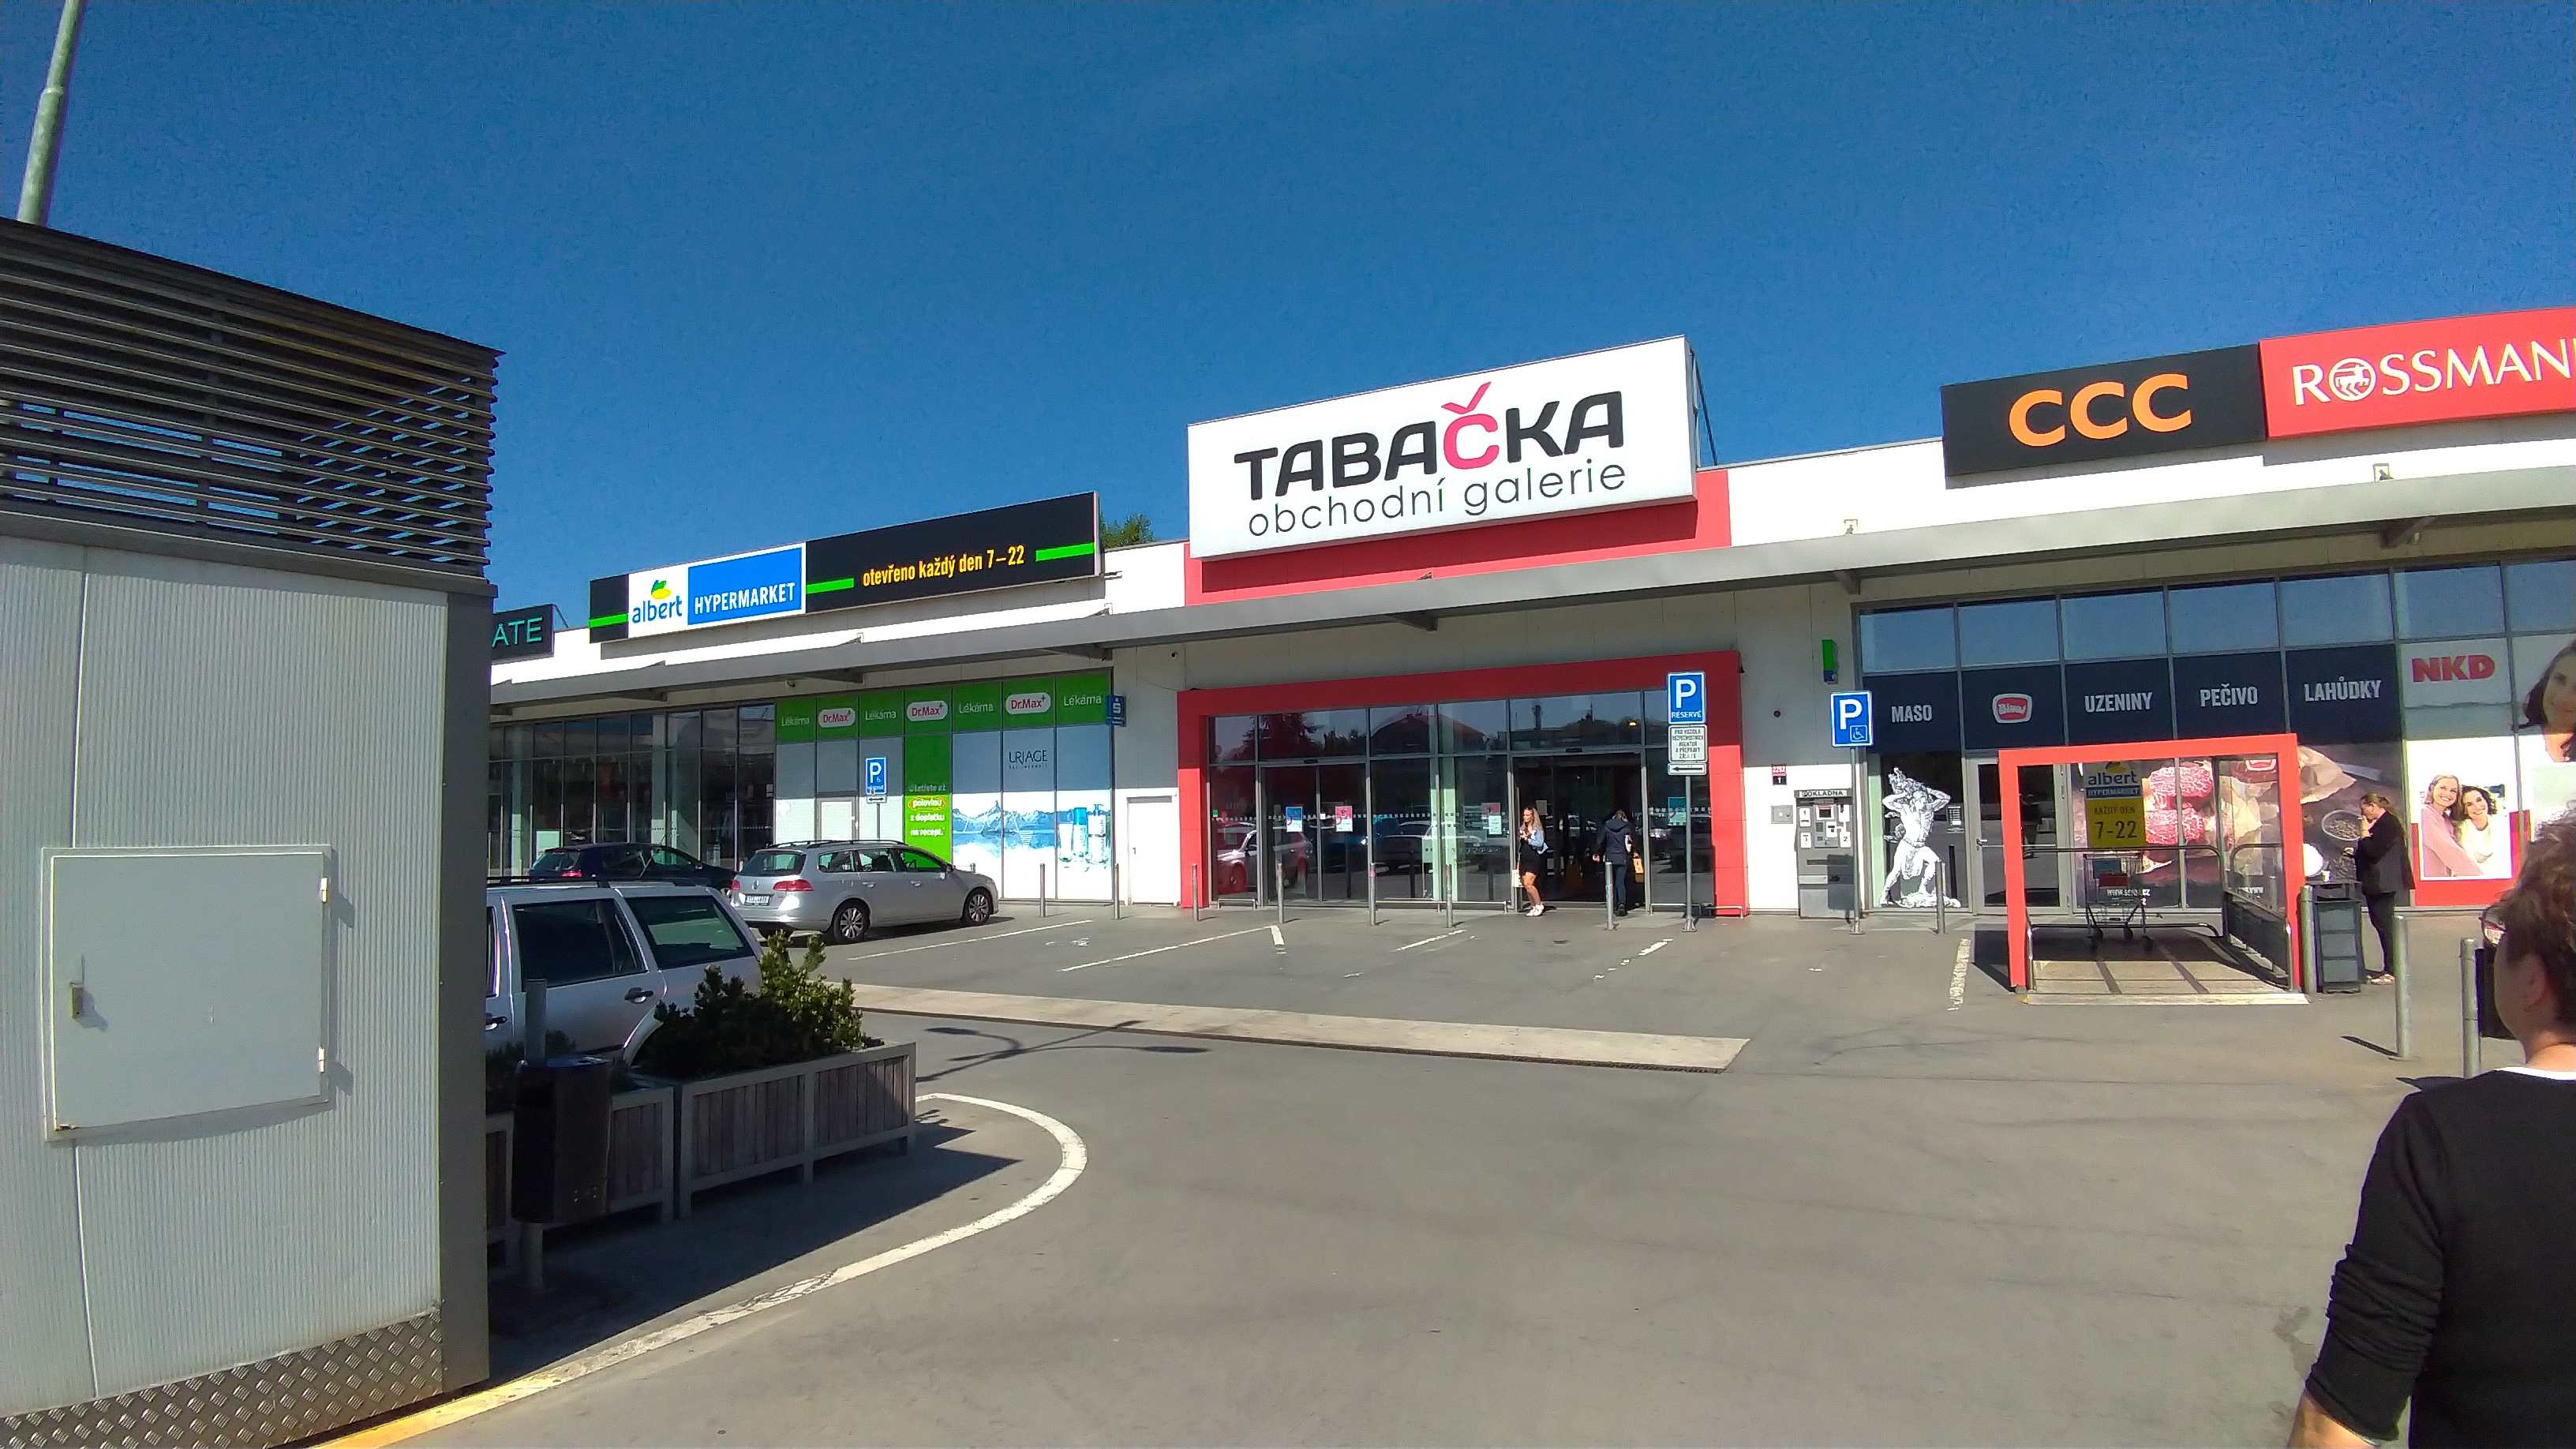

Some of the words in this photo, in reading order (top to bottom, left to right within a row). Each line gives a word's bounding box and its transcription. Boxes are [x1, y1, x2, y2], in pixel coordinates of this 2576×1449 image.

[2293, 338, 2576, 406] ROSSMAN
[2009, 373, 2192, 447] CCC
[1234, 381, 1623, 501] TABAČKA
[1249, 477, 1445, 537] obchodní
[1464, 459, 1626, 516] galerie
[863, 564, 915, 587] otevřeno
[919, 554, 955, 578] každý
[959, 554, 983, 573] den
[632, 594, 683, 623] albert
[694, 582, 796, 615] HYPERMARKET
[2412, 654, 2496, 683] NKD
[1064, 694, 1102, 706] Lékárna
[1676, 679, 1697, 709] P
[2084, 692, 2152, 713] UZENINY
[2199, 683, 2258, 707] PEČIVO
[2304, 676, 2381, 702] LAHŮDKY
[959, 702, 994, 713] Lékárna
[1839, 698, 1863, 730] P
[1891, 705, 1932, 723] MASO
[1009, 750, 1048, 766] URIAGE
[870, 762, 882, 784] P
[2087, 770, 2137, 785] albert
